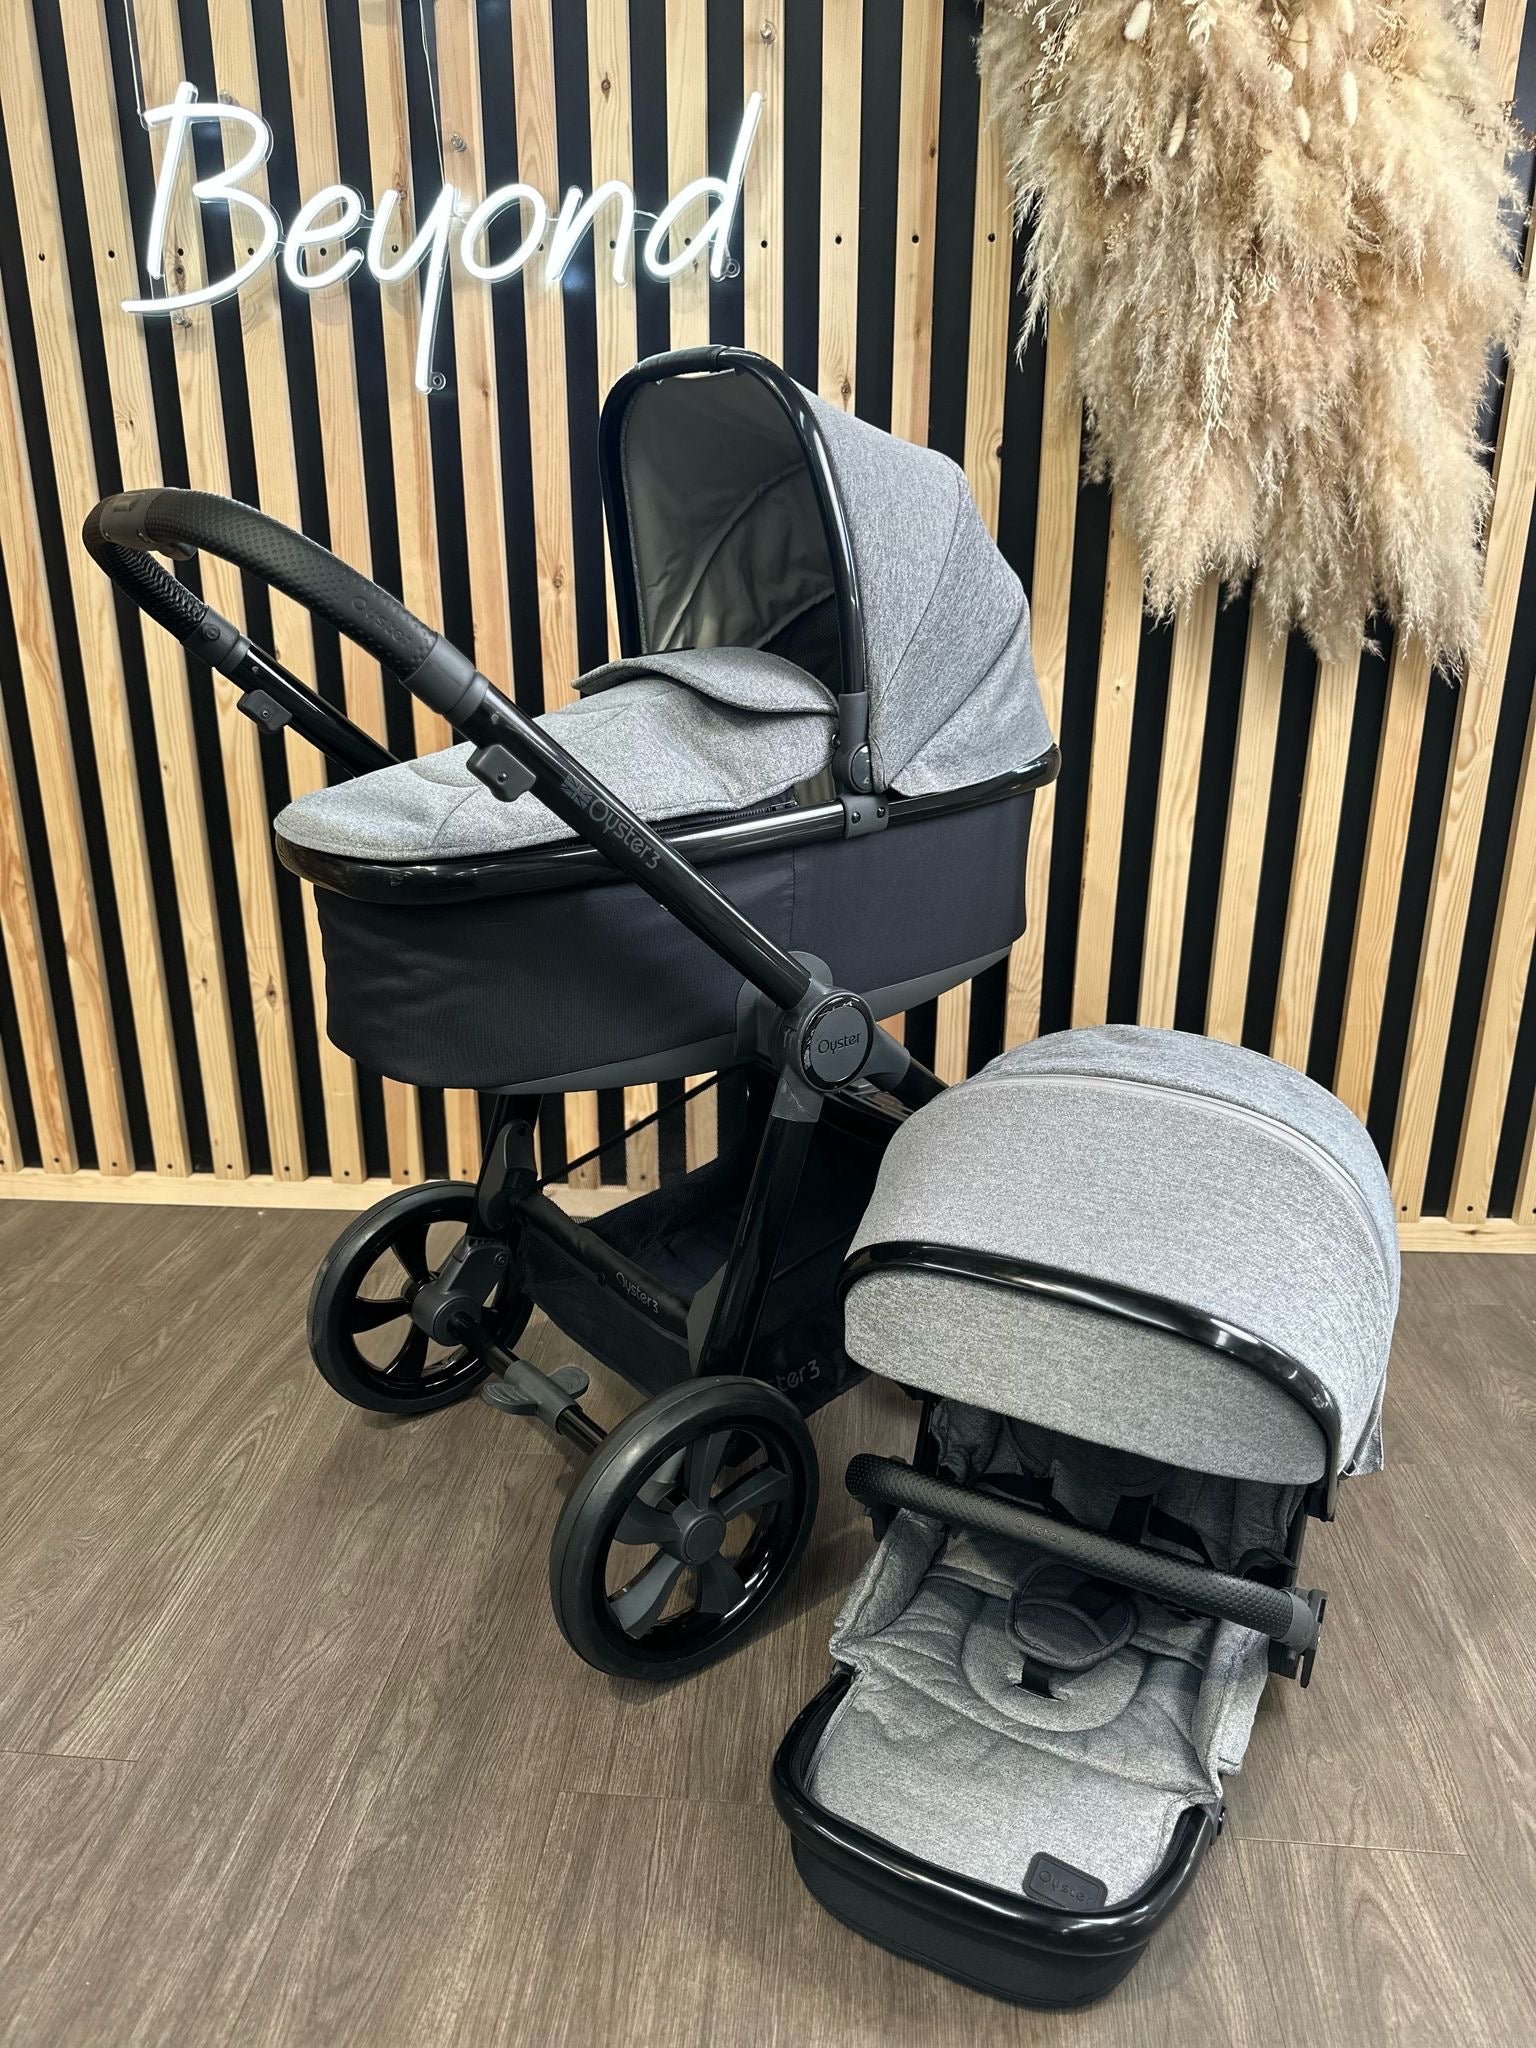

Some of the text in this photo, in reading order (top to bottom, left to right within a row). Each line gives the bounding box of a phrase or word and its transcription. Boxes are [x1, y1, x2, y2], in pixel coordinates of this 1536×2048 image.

[121, 80, 766, 392] Beyond
[817, 1032, 862, 1055] Oyster
[1038, 1870, 1095, 1906] Oyster
